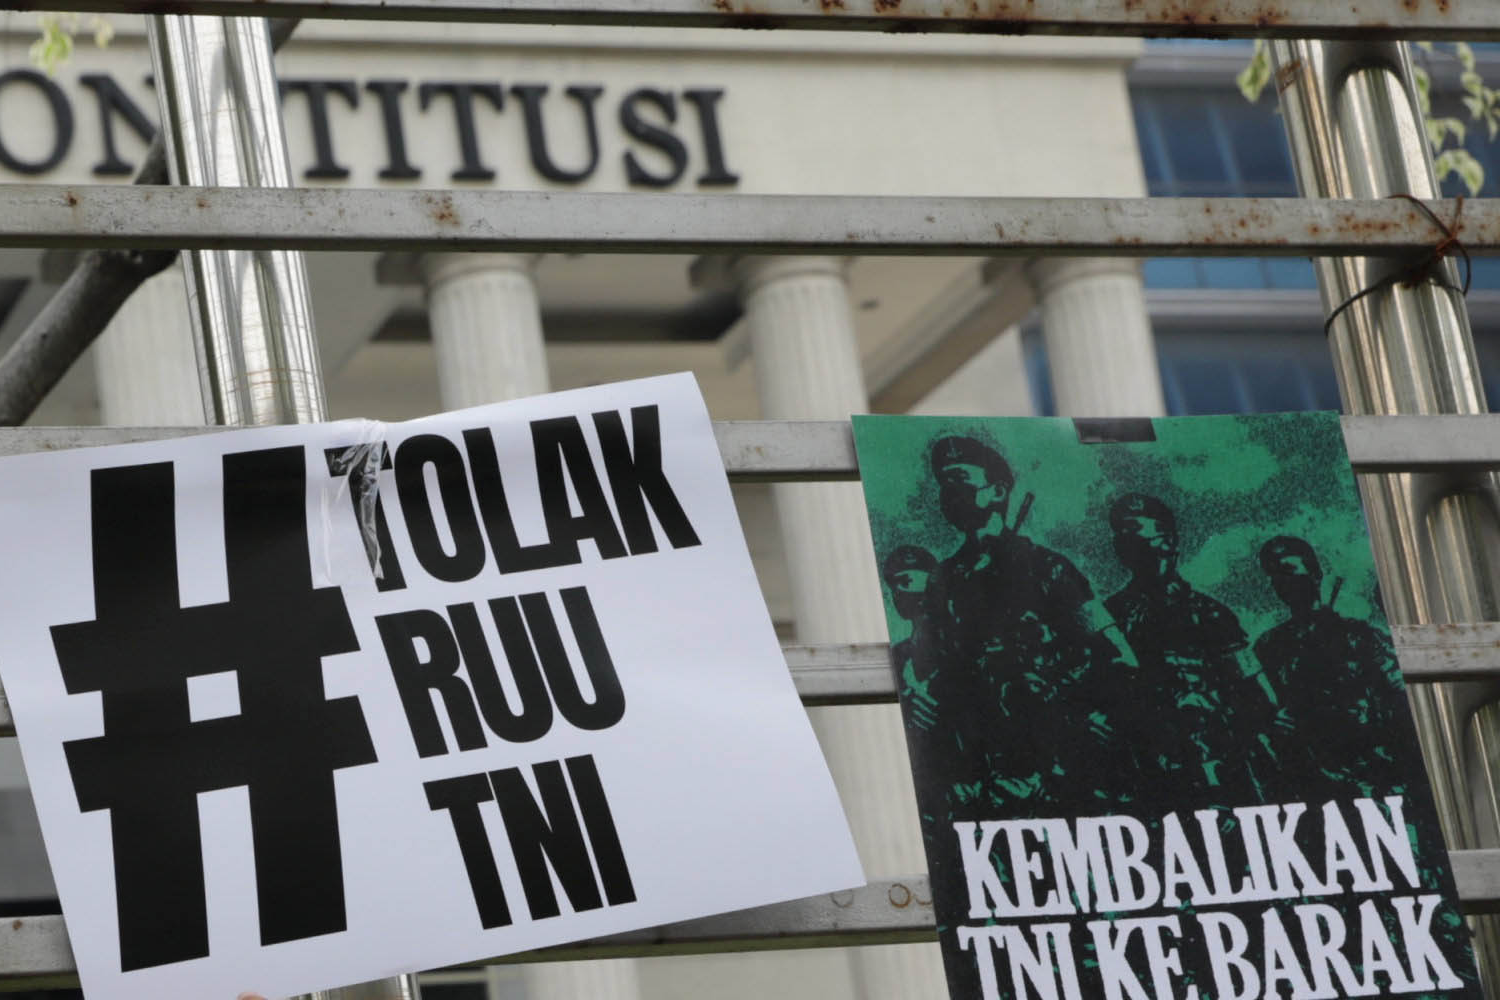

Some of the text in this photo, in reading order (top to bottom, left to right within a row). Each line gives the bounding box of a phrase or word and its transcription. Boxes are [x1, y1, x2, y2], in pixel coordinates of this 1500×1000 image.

[326, 403, 702, 592] TOLAK
[374, 586, 627, 759] RUU
[422, 754, 637, 930] TNI
[953, 795, 1421, 920] KEMBALIKAN
